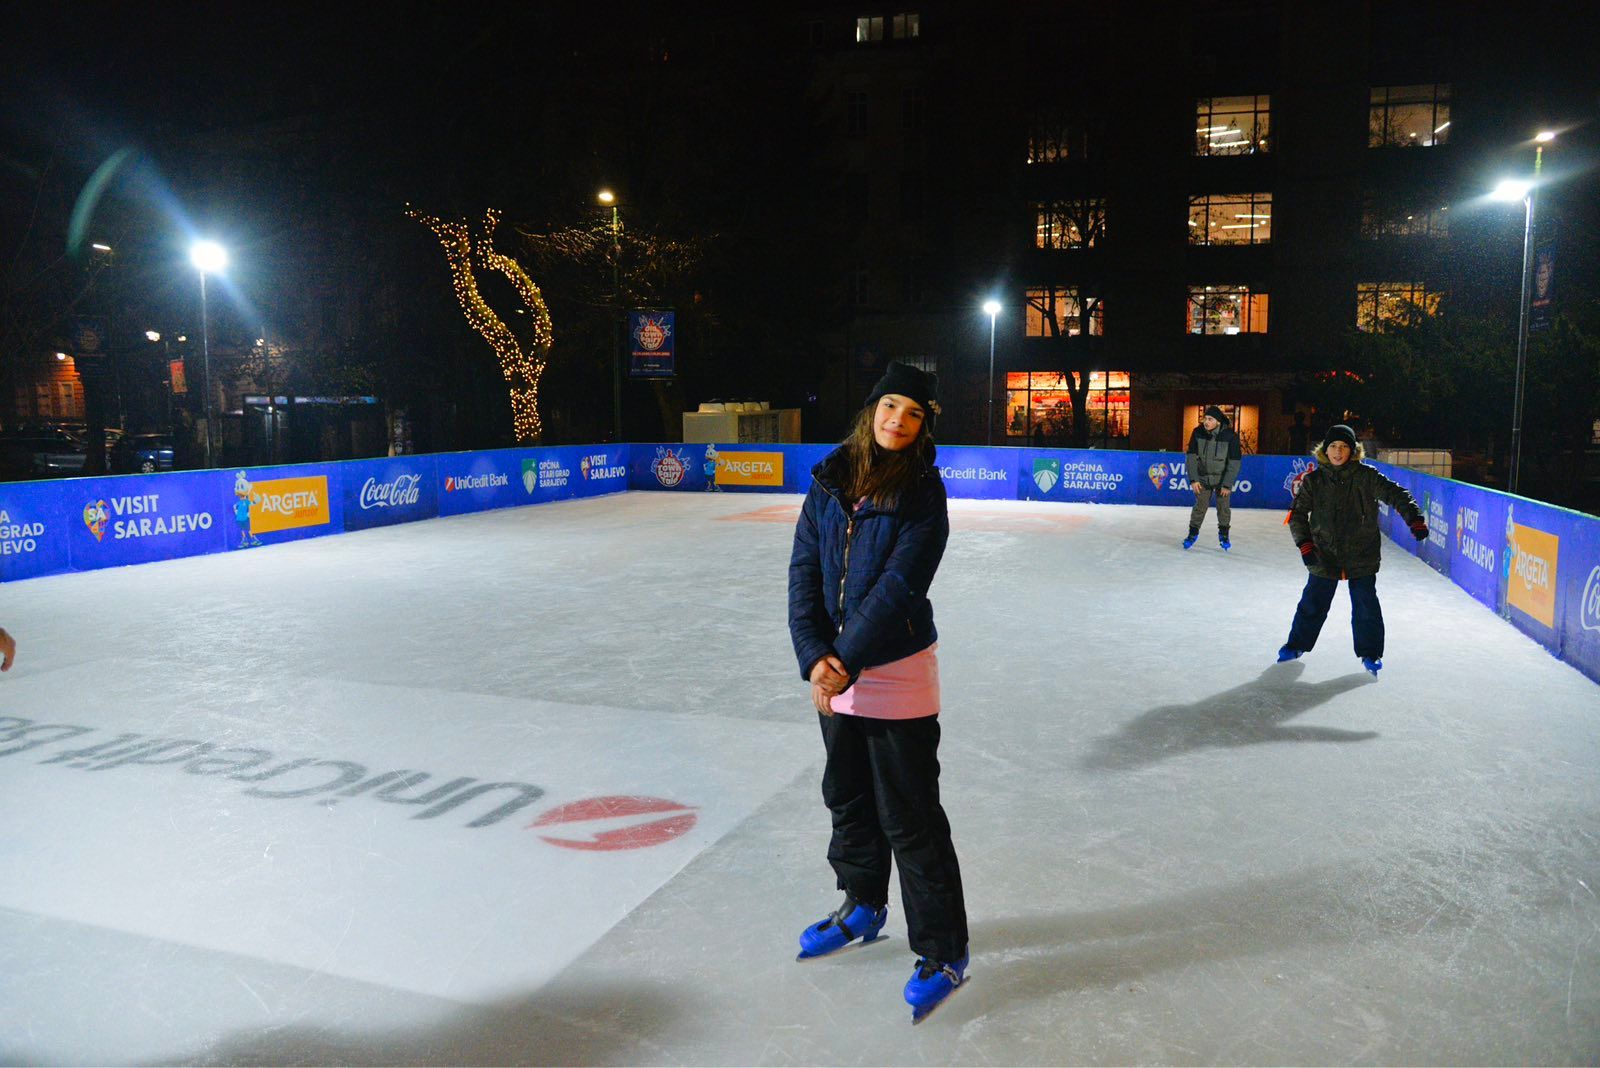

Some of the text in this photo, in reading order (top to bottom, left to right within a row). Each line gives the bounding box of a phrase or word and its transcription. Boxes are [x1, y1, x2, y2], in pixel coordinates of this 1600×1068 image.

[589, 454, 607, 466] VISIT
[724, 460, 773, 476] ARGETA
[1063, 460, 1103, 473] OPĆINA
[539, 469, 570, 478] STARI GRAD
[590, 463, 626, 480] SARAJEVO
[978, 468, 1008, 481] Bank
[1063, 471, 1123, 483] STARI GRAD
[454, 472, 509, 490] UniCredit Bank
[539, 478, 567, 487] SARAJEVO
[1062, 480, 1117, 492] SARAJEVO
[111, 494, 159, 515] VISIT
[261, 490, 318, 515] ARGETA
[114, 513, 212, 539] SARAJEVO
[1463, 506, 1479, 534] VISIT
[0, 522, 45, 539] GRAD
[1461, 534, 1495, 573] SARAJEVO
[1515, 546, 1548, 592] ARGETA
[35, 731, 546, 829] UniCredit
